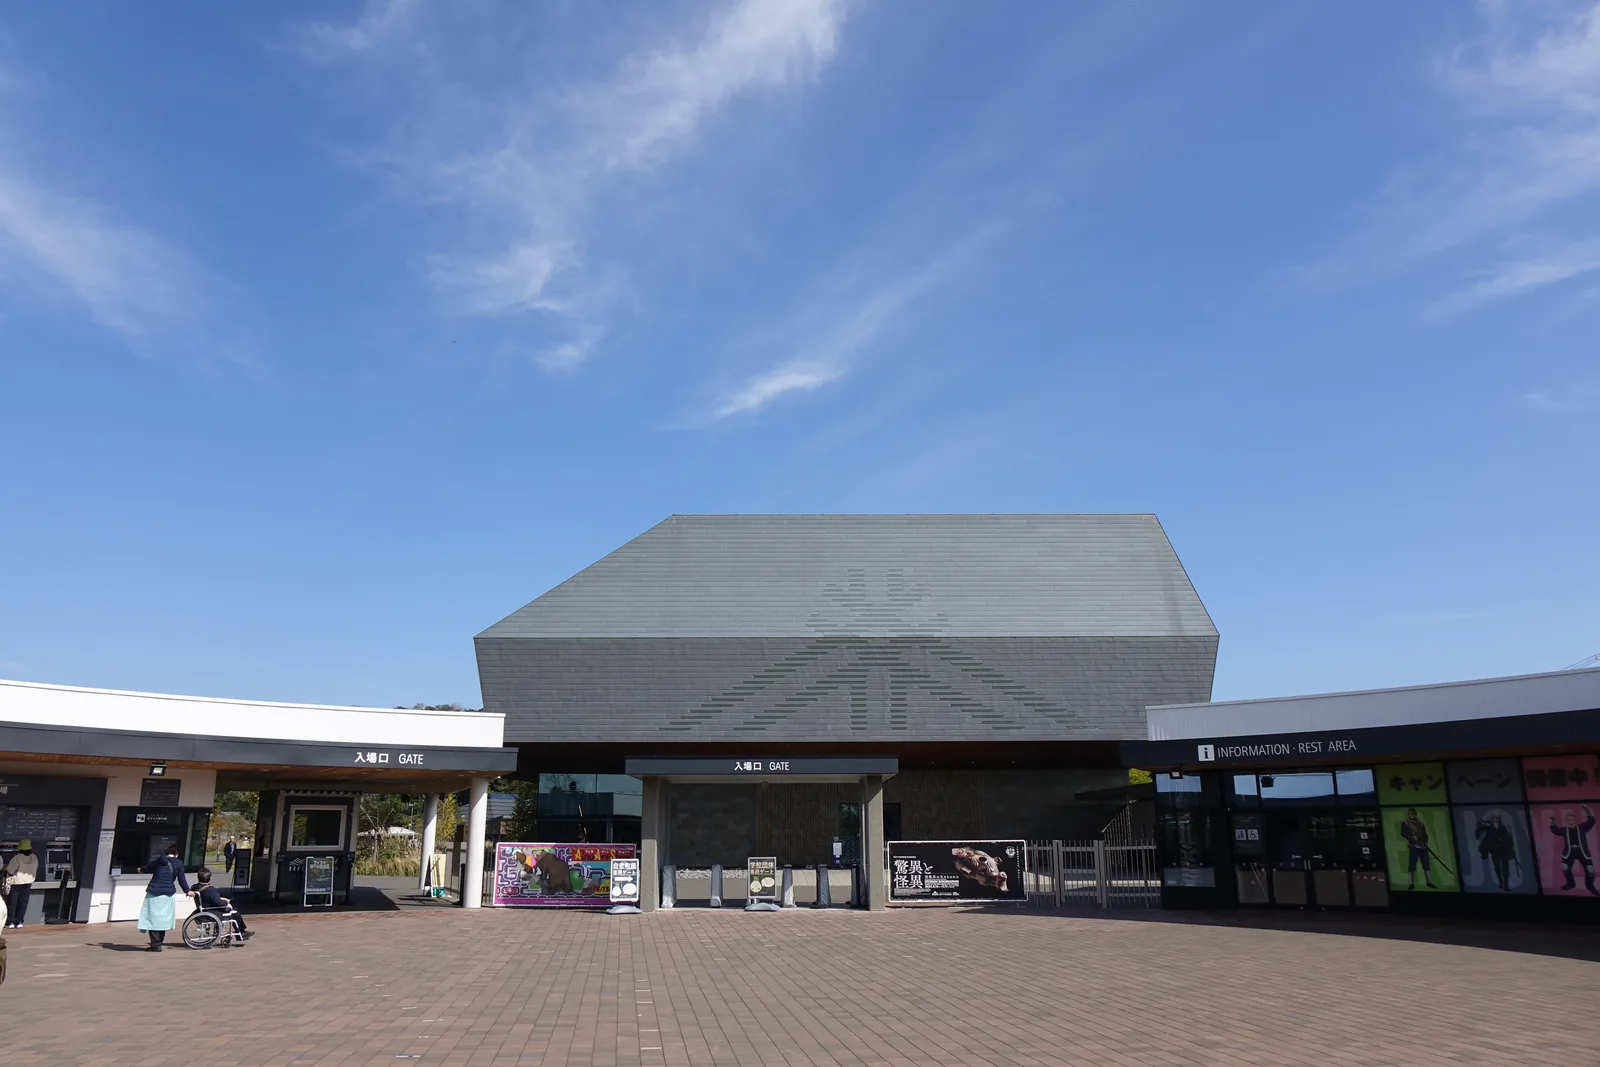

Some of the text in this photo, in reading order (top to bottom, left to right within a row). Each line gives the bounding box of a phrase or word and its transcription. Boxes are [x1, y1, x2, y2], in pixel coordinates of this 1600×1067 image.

[1217, 743, 1290, 758] INFORMATION
[1298, 741, 1323, 755] REST
[1328, 739, 1358, 753] AREA
[354, 752, 424, 765] 入場口 GATE
[734, 761, 791, 771] 入場口 GATE
